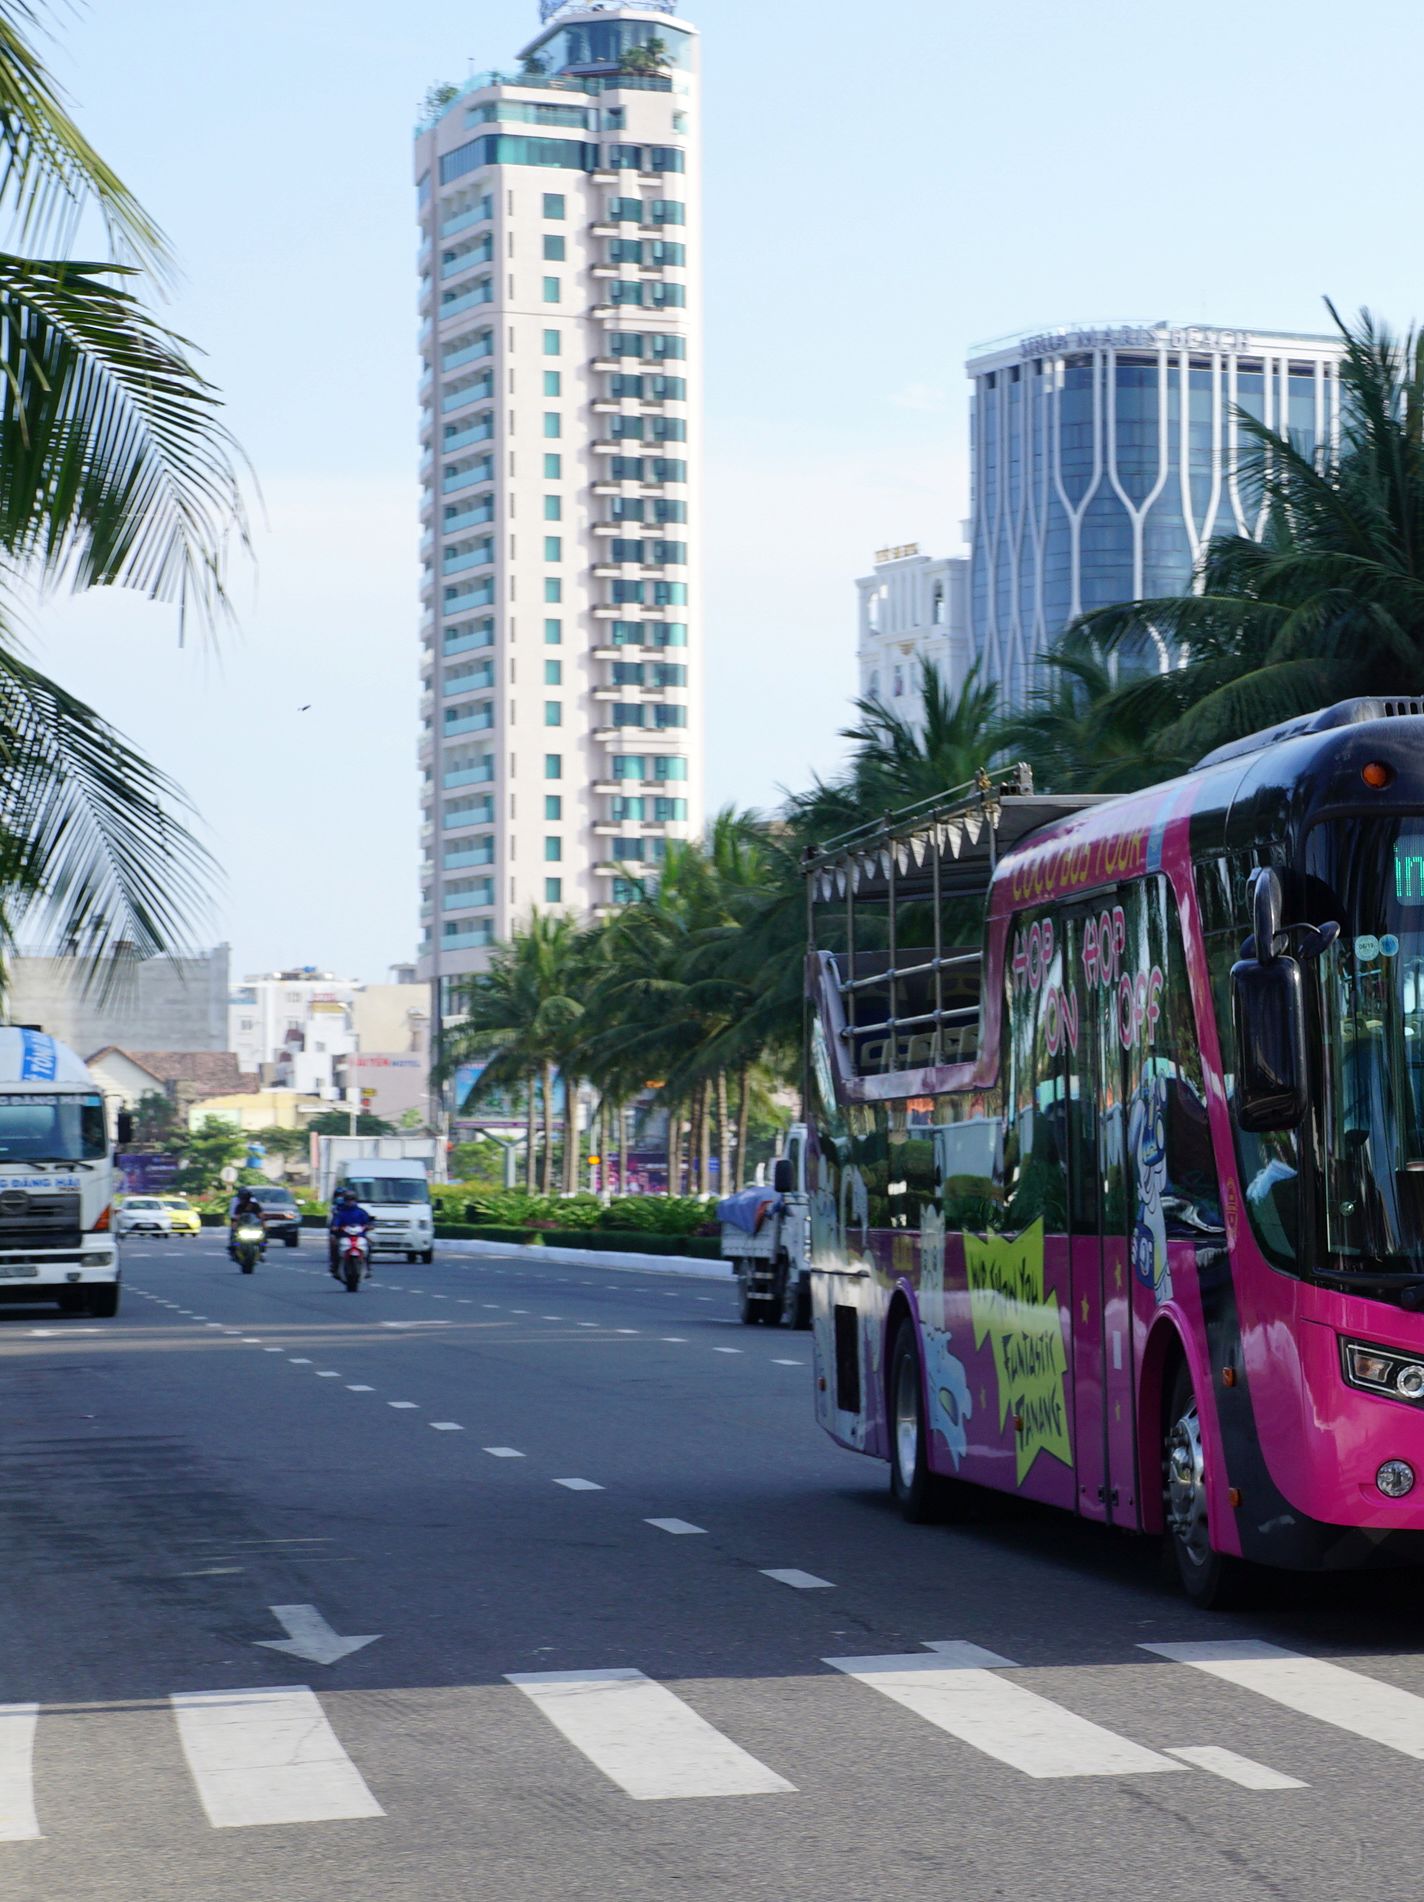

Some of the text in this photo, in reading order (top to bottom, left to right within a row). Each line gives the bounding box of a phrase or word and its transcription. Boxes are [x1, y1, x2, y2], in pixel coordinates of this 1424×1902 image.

[1171, 327, 1250, 353] BEACH
[1012, 829, 1146, 902] COCO BUS TOUR
[1012, 905, 1126, 994] HOP HOP
[1045, 965, 1164, 1057] ON OFF
